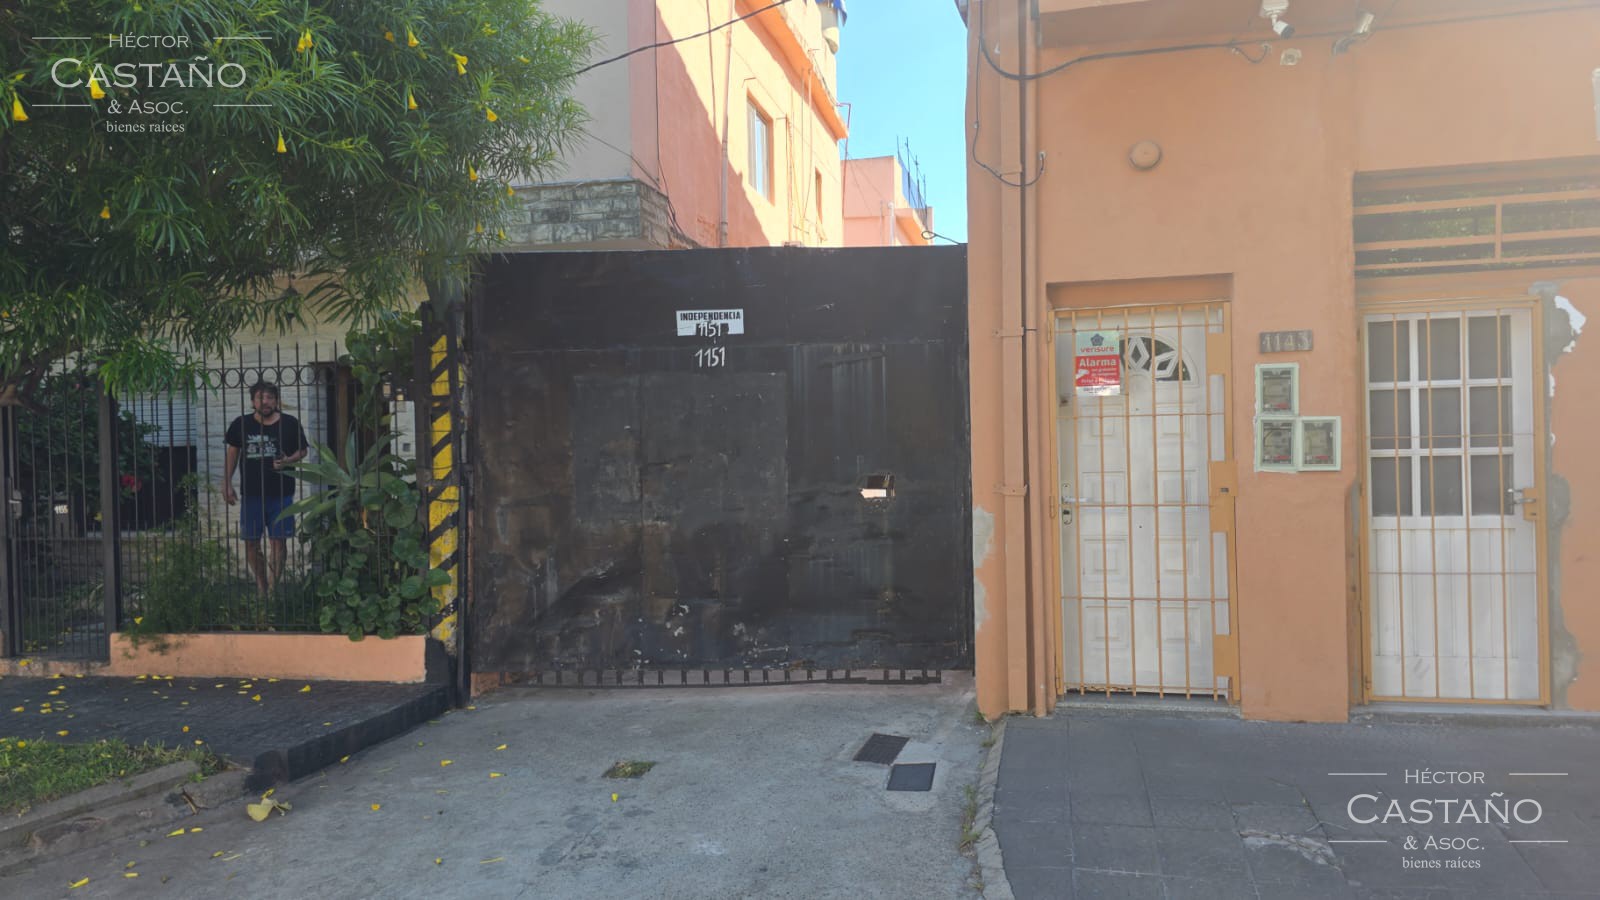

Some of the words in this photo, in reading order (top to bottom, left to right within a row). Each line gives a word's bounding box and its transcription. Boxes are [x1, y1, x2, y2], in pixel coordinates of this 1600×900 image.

[680, 311, 741, 321] INDEPENDENCIA
[698, 321, 721, 337] 1151
[694, 346, 726, 368] 1151
[1079, 358, 1117, 367] Alarma
